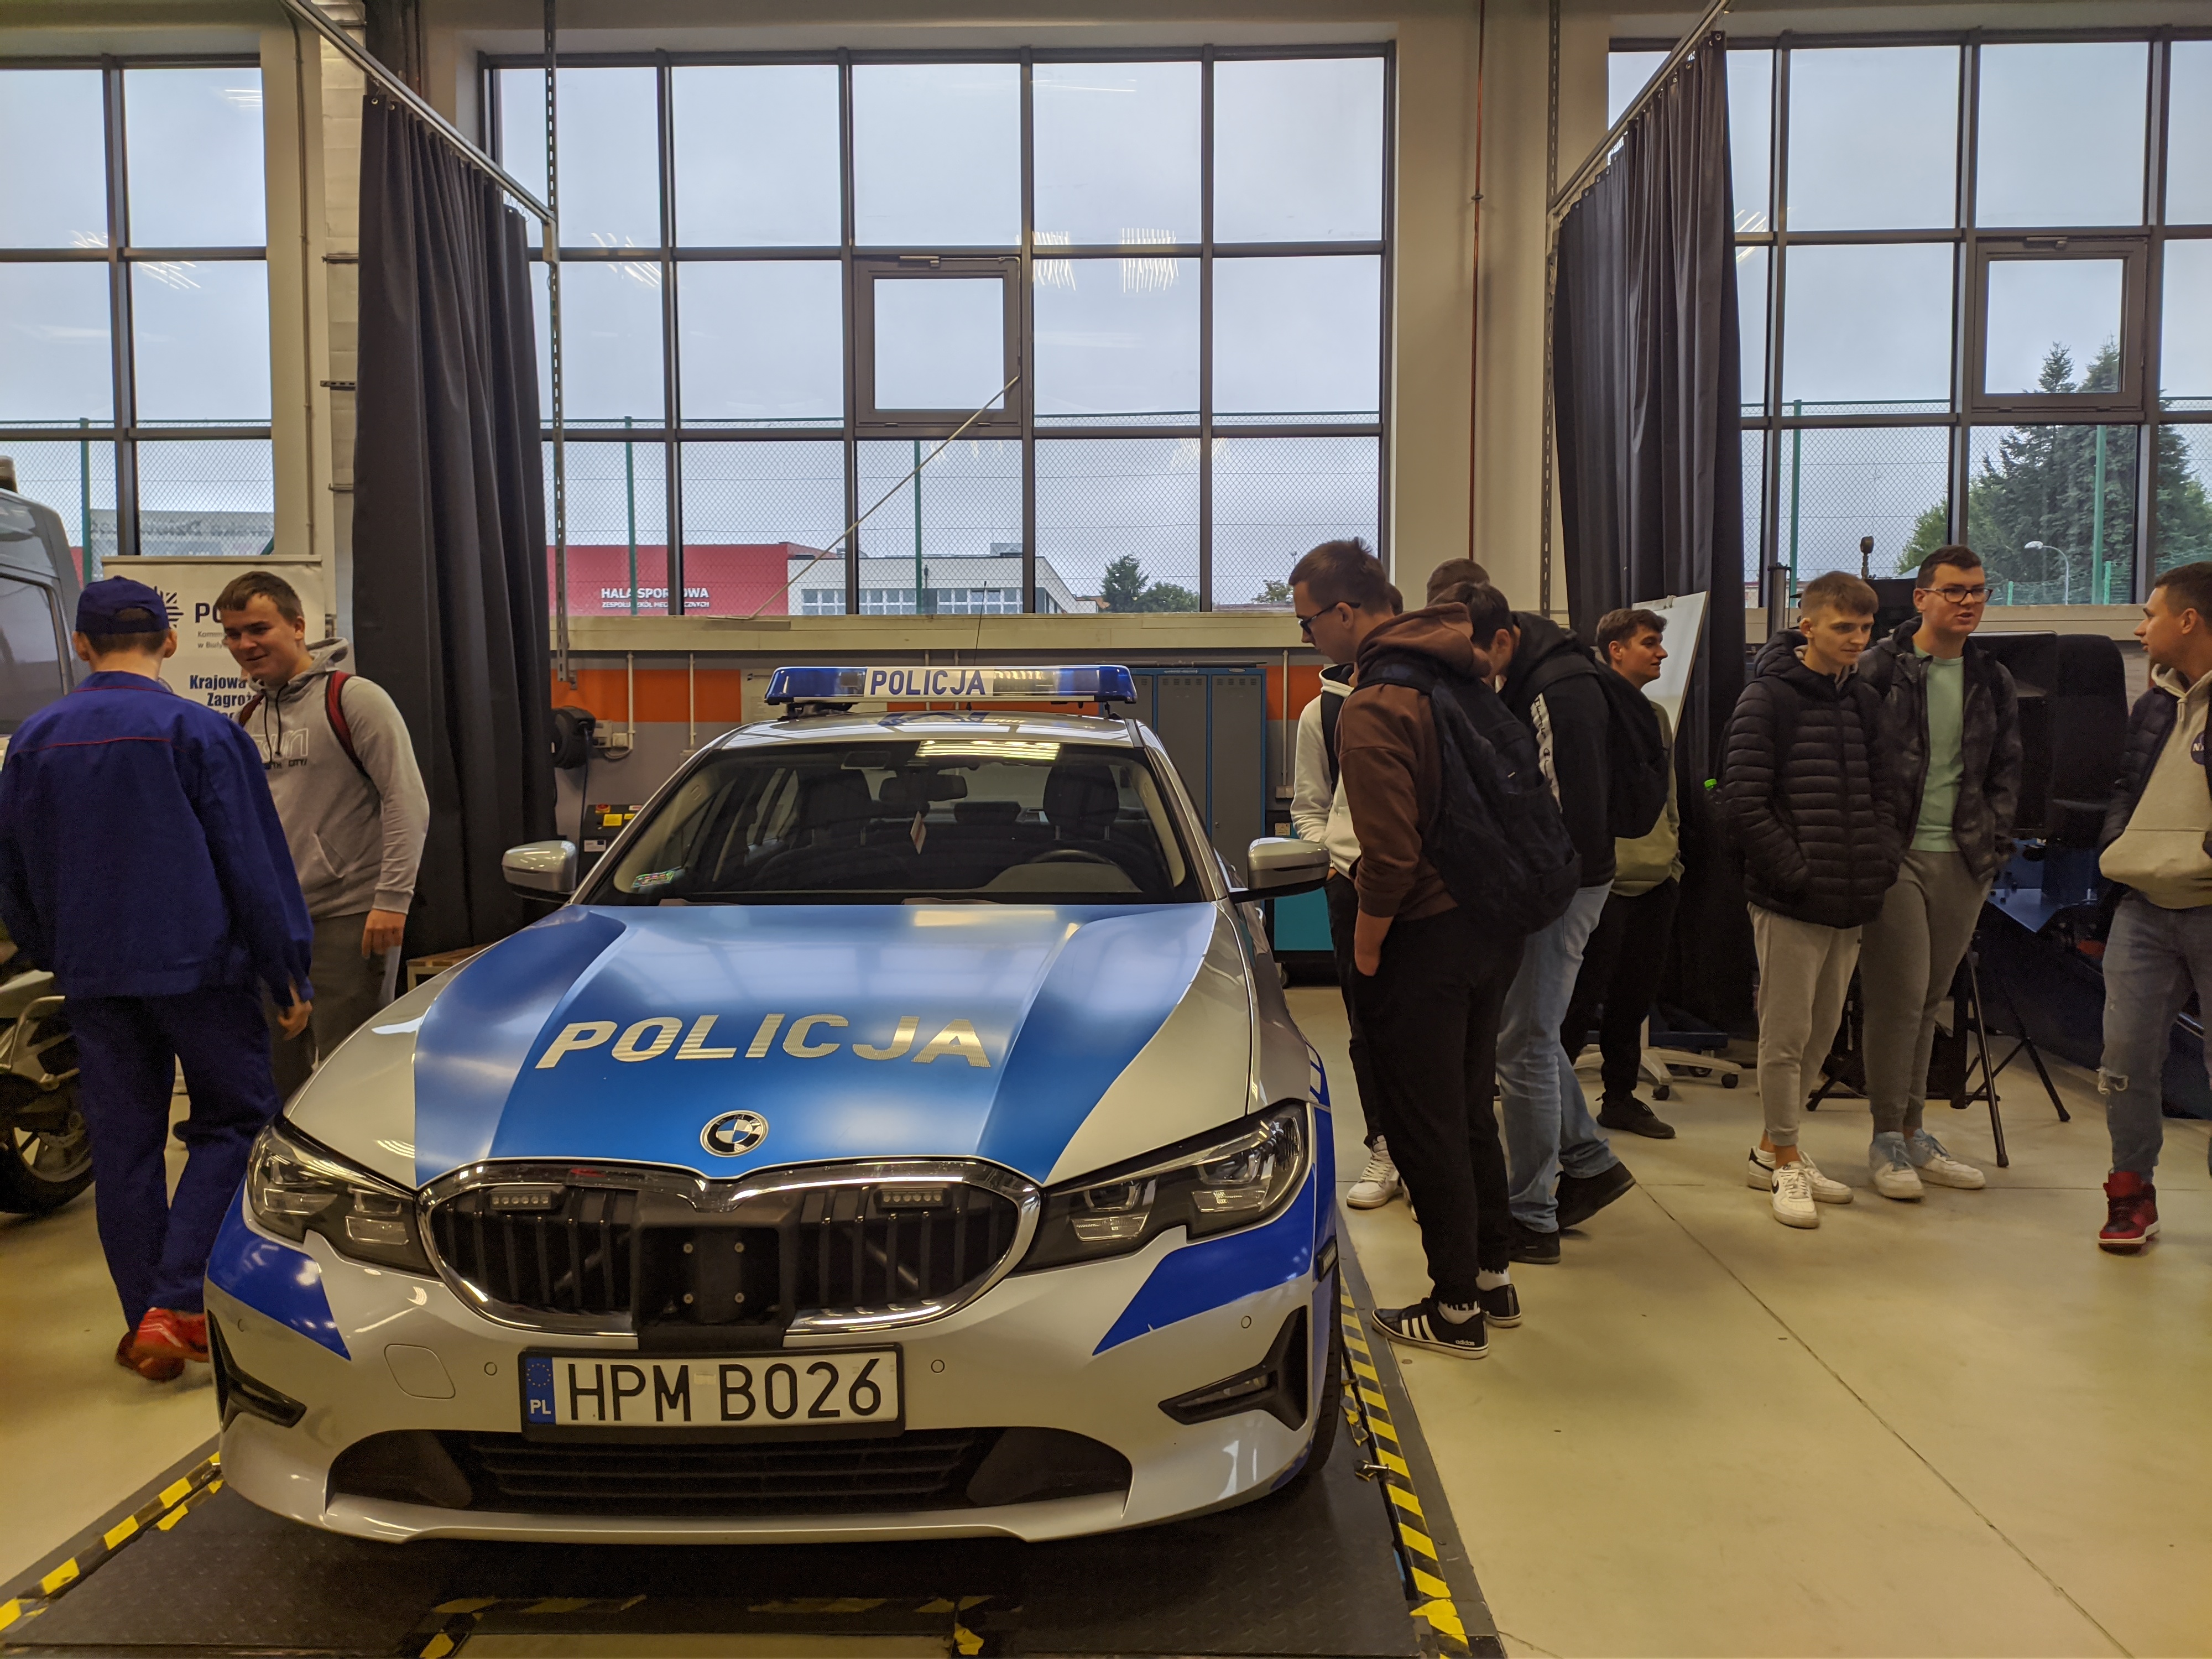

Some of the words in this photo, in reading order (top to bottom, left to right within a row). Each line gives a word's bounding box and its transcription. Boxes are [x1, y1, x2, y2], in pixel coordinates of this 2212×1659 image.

[637, 588, 709, 598] SPORWA
[190, 675, 247, 690] Krajowa
[870, 670, 986, 695] POLICJA
[534, 1013, 992, 1069] POLICJA
[567, 1363, 692, 1422] HPM
[718, 1358, 881, 1421] B026
[529, 1399, 551, 1415] PL
